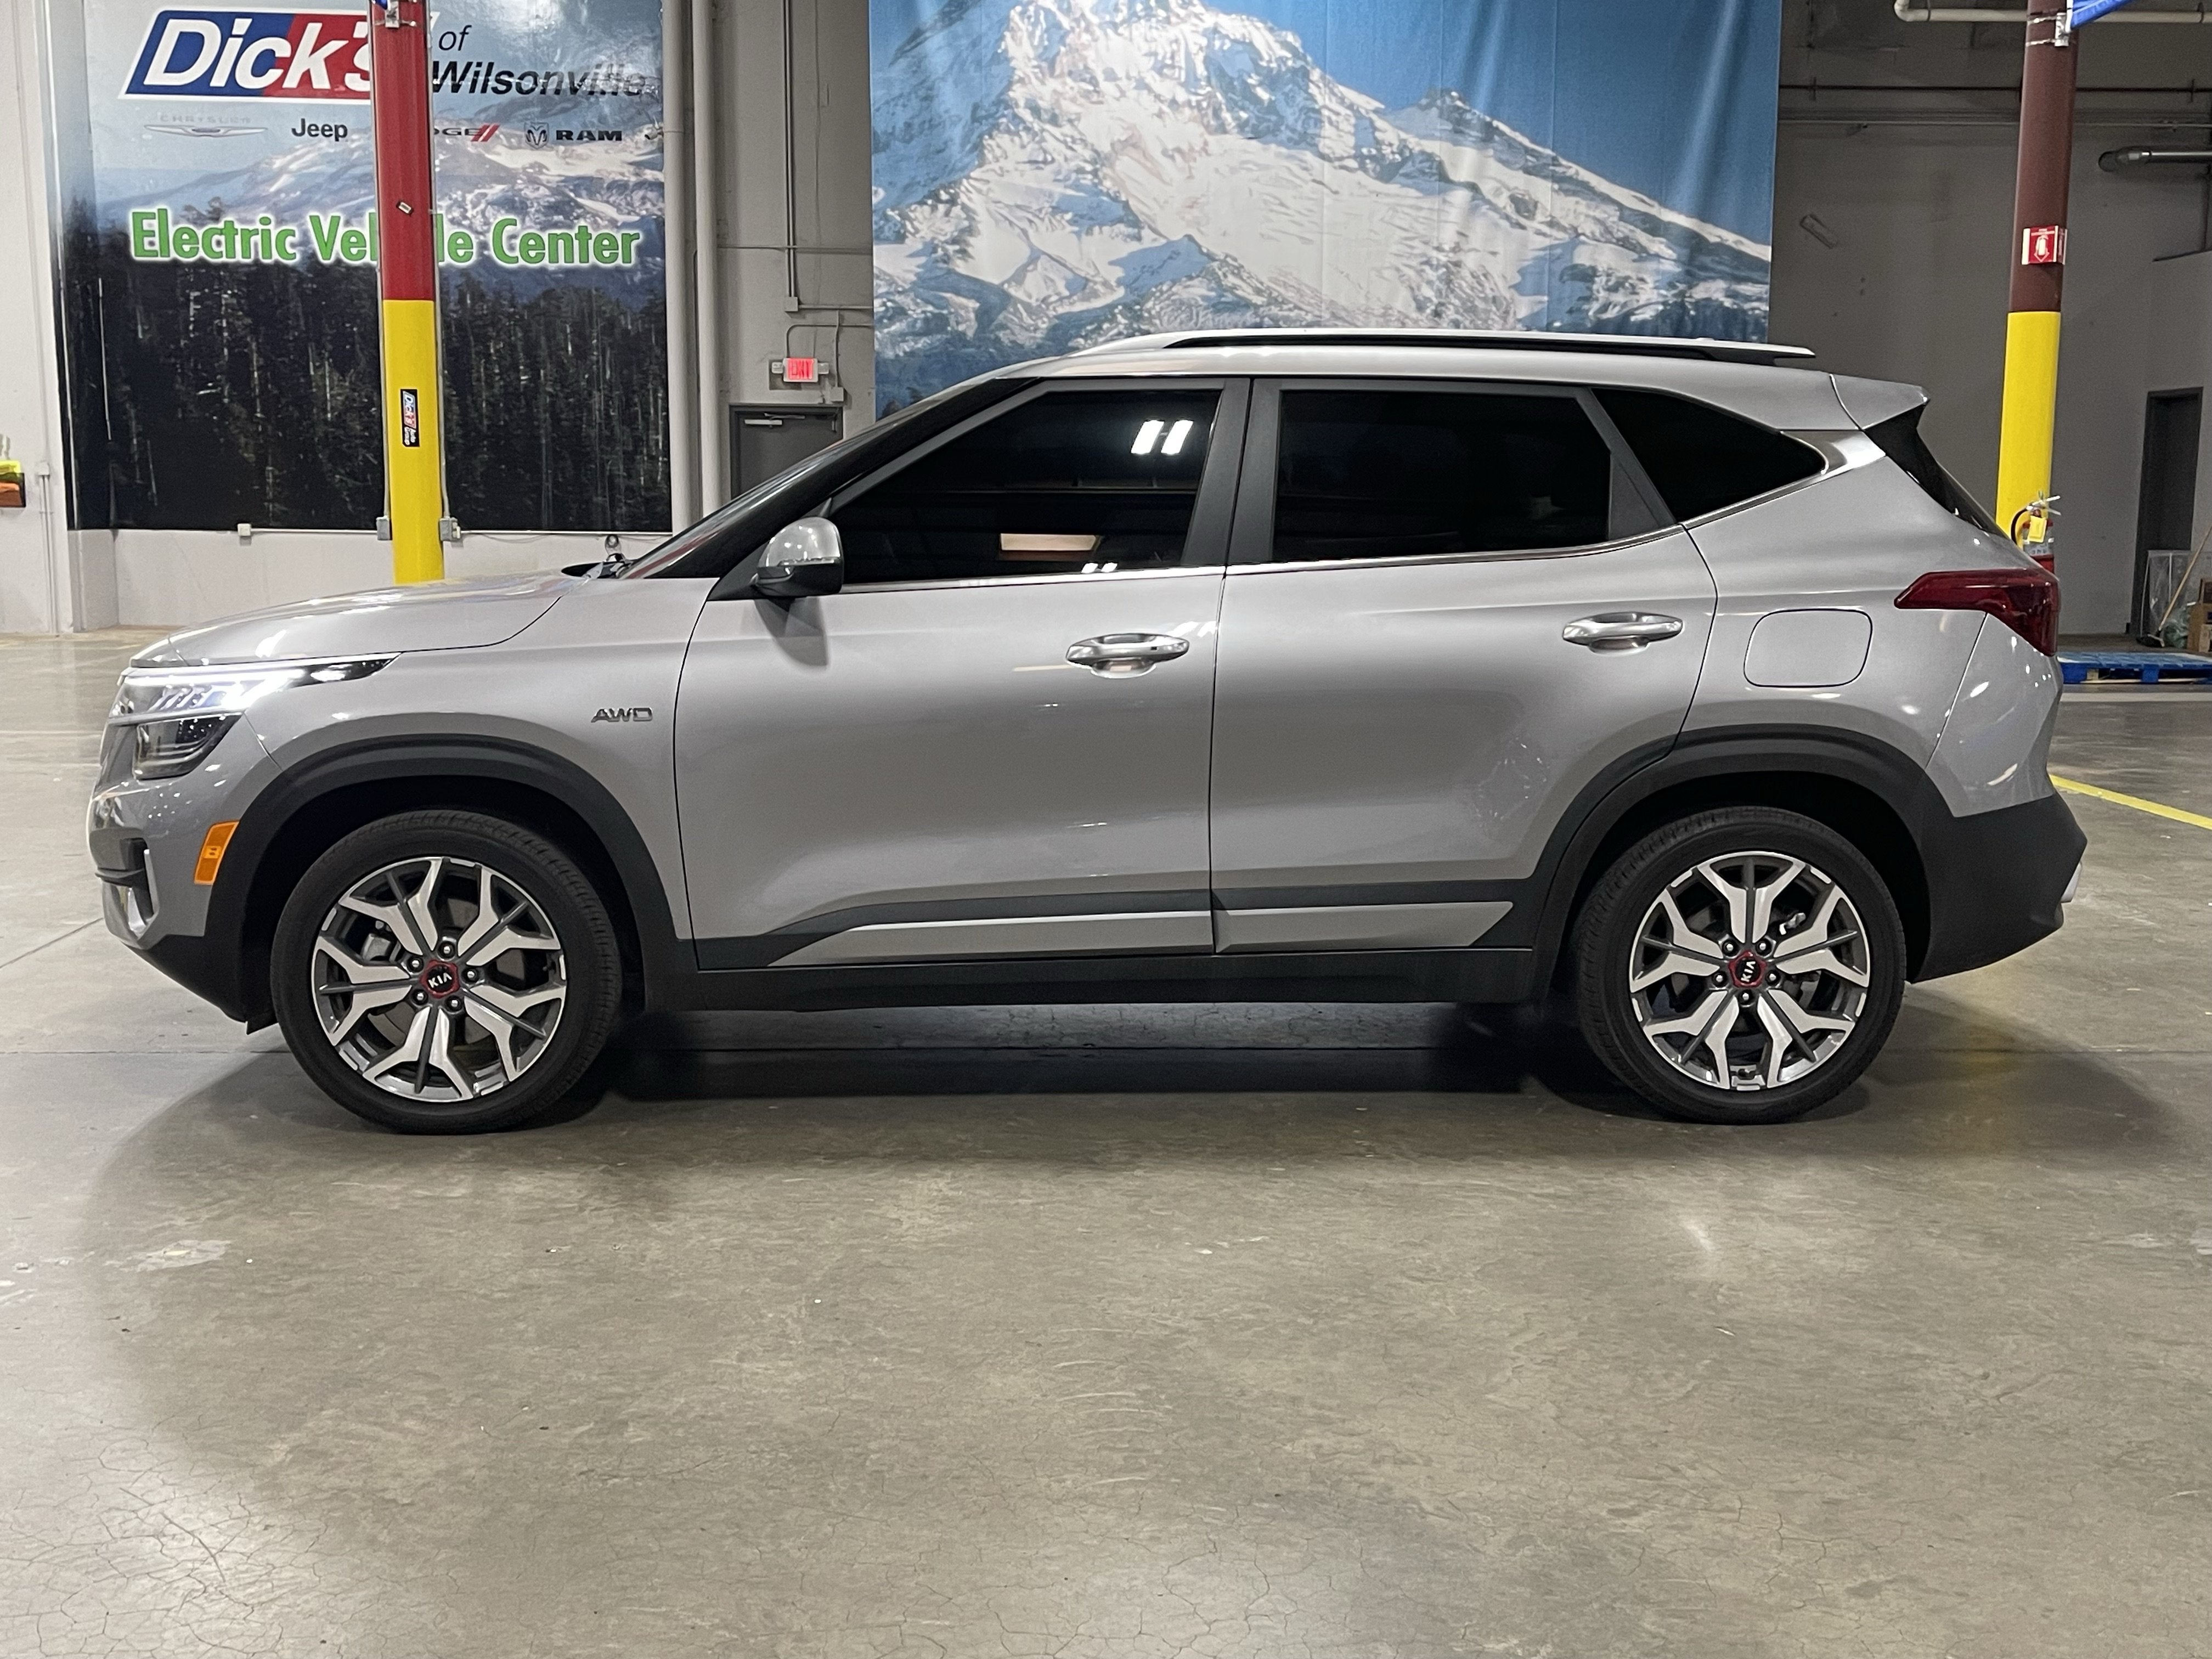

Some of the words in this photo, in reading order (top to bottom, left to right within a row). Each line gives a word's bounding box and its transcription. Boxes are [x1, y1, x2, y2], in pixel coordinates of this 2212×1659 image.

[438, 25, 472, 51] of
[433, 60, 645, 96] Wilsonville
[291, 119, 348, 142] Jeep
[556, 129, 623, 141] RAM
[132, 208, 297, 261] Electric
[309, 212, 474, 263] Vele
[493, 218, 640, 264] Center
[789, 358, 814, 380] EXIT
[591, 708, 653, 723] AWD
[428, 972, 453, 988] KIA
[1740, 961, 1756, 983] KIA
